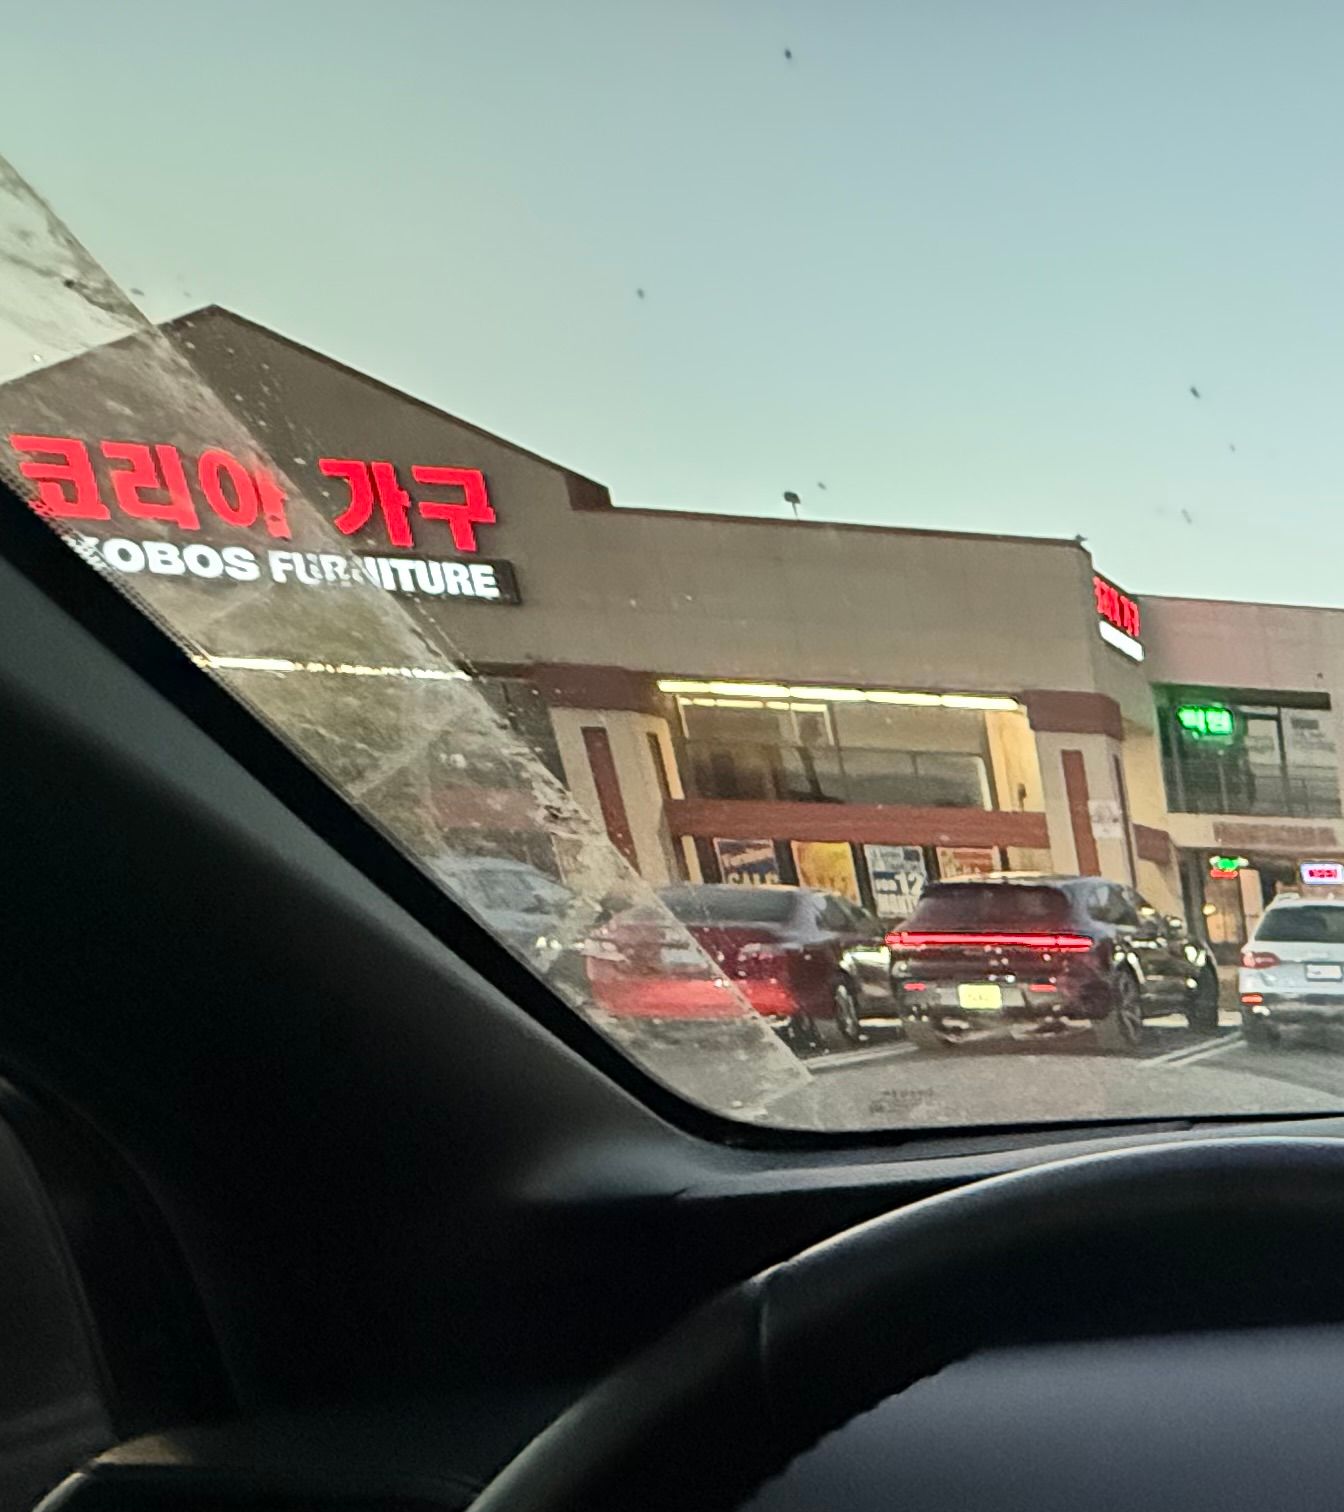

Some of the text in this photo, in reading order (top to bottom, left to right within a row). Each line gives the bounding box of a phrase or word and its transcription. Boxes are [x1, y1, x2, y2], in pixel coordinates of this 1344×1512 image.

[9, 434, 497, 552] 코리아 가구
[268, 550, 500, 599] FURNITURE
